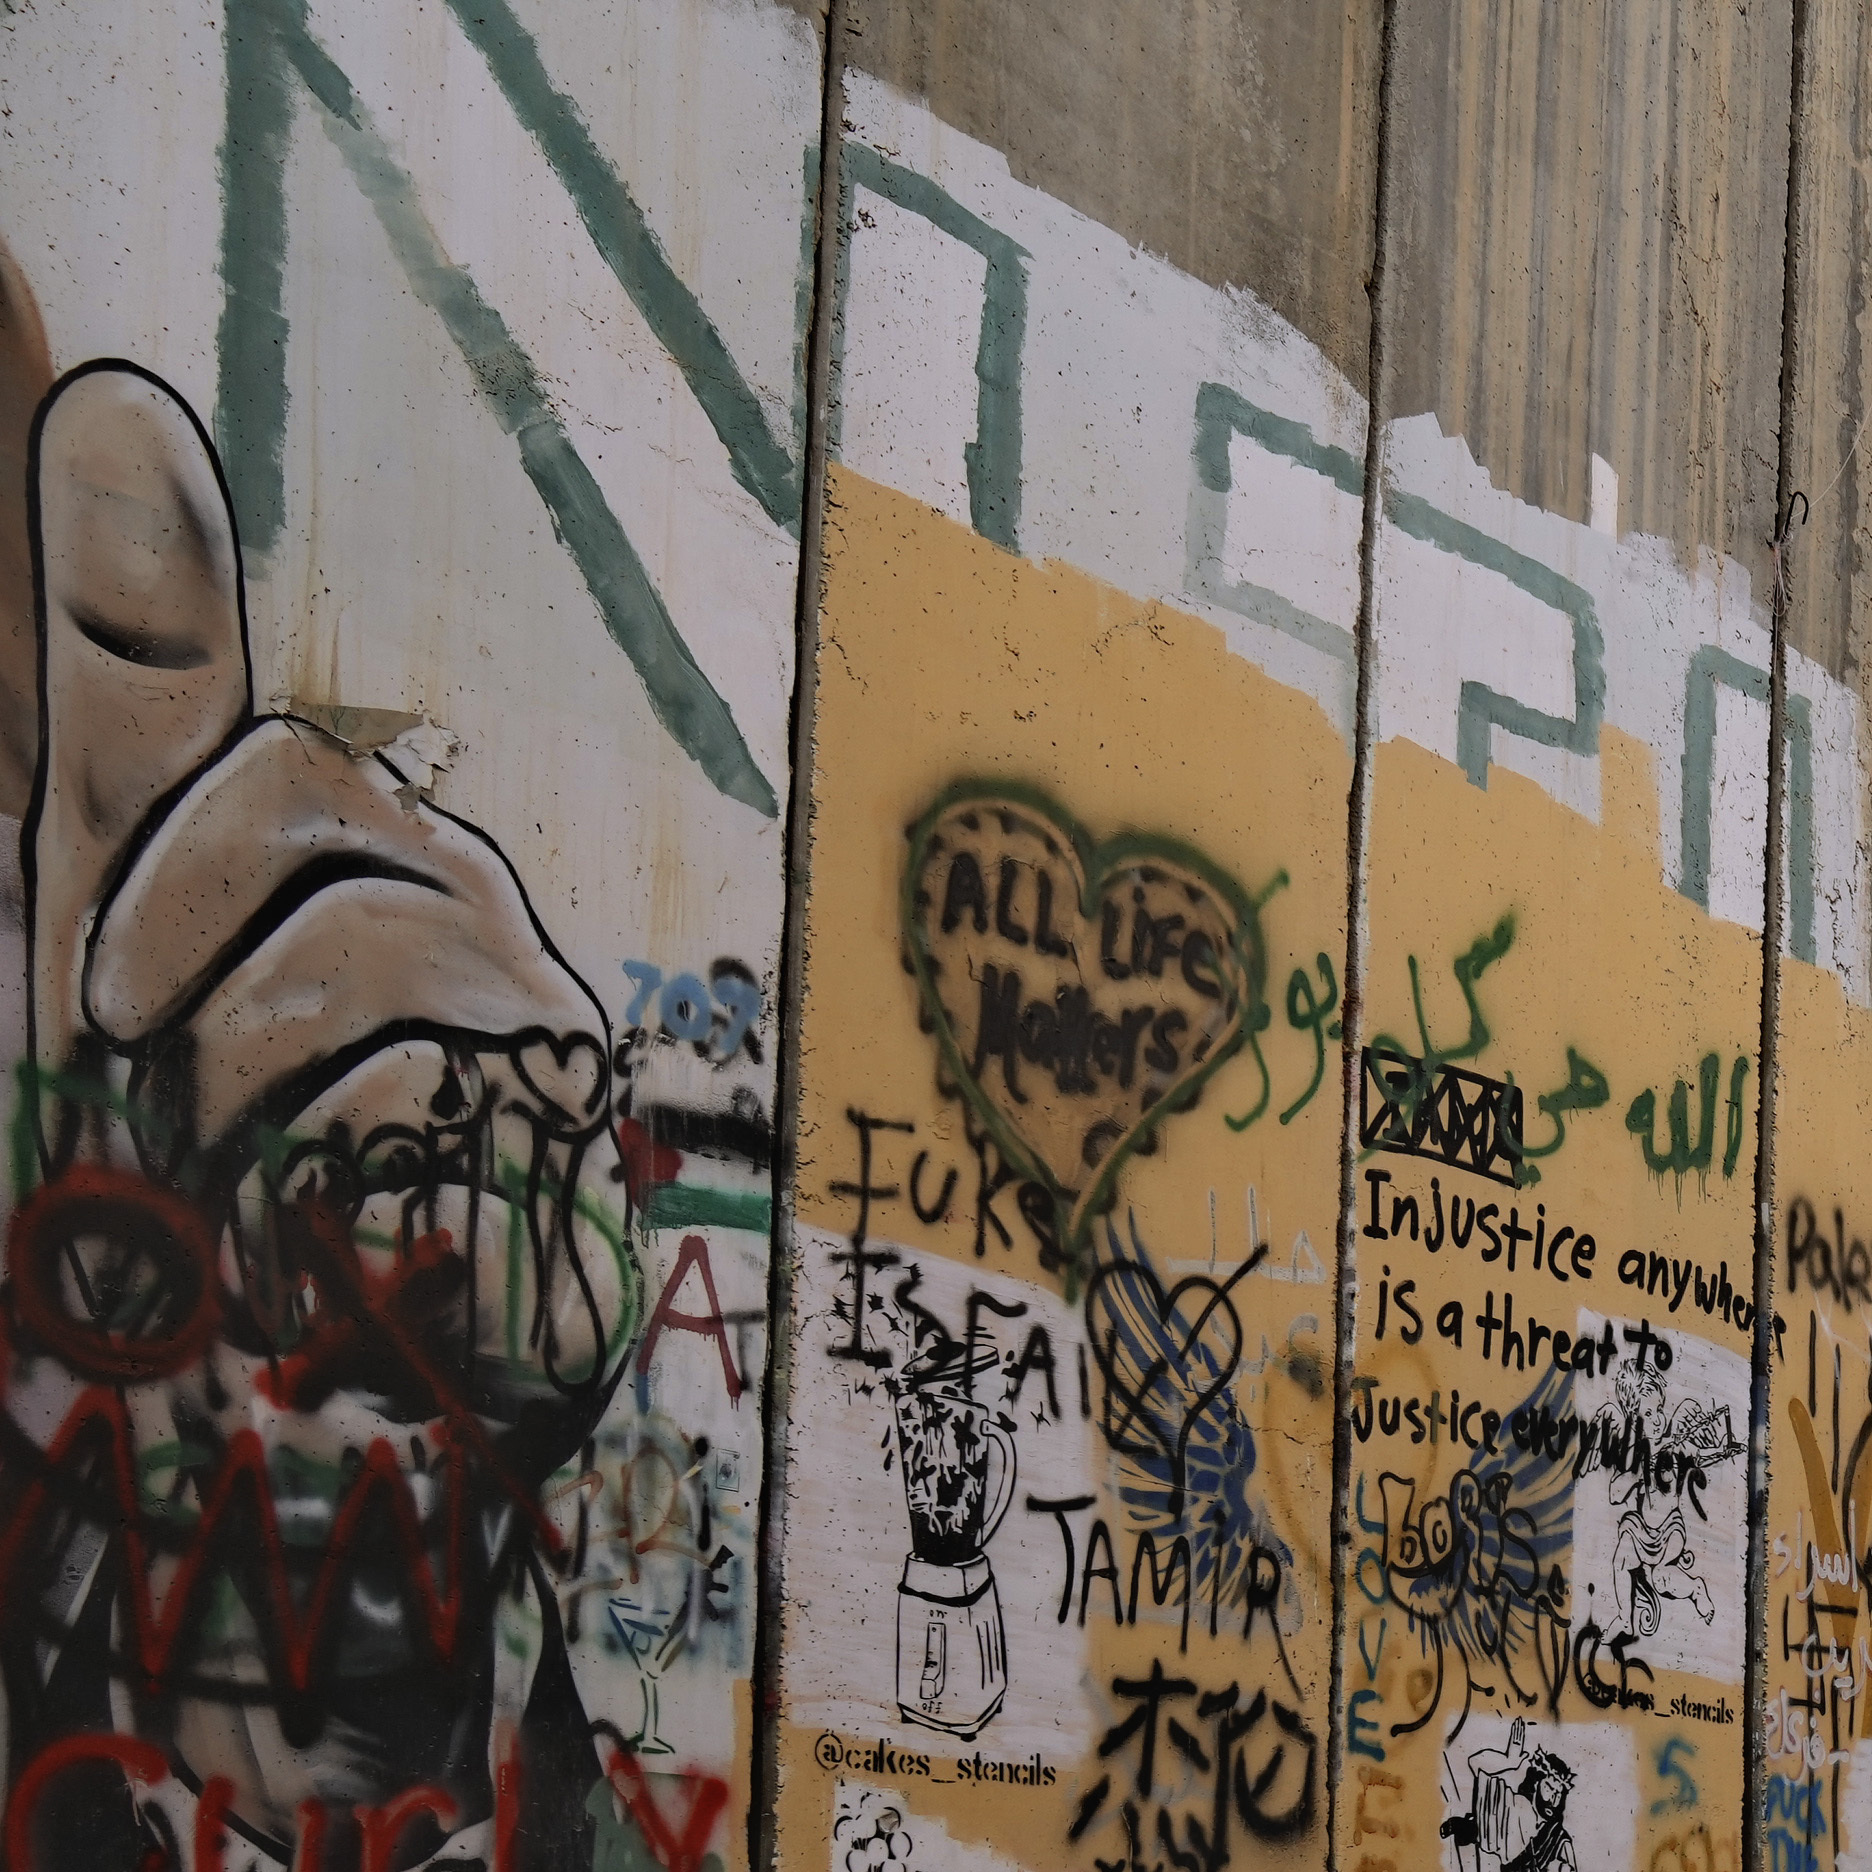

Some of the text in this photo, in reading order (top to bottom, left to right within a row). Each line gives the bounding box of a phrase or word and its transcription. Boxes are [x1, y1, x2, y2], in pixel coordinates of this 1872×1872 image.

[940, 851, 1074, 958] ALL
[1362, 1168, 1597, 1282] Injustice
[1374, 1264, 1673, 1378] is a threat to
[814, 1733, 1056, 1787] @cakes_stencils
